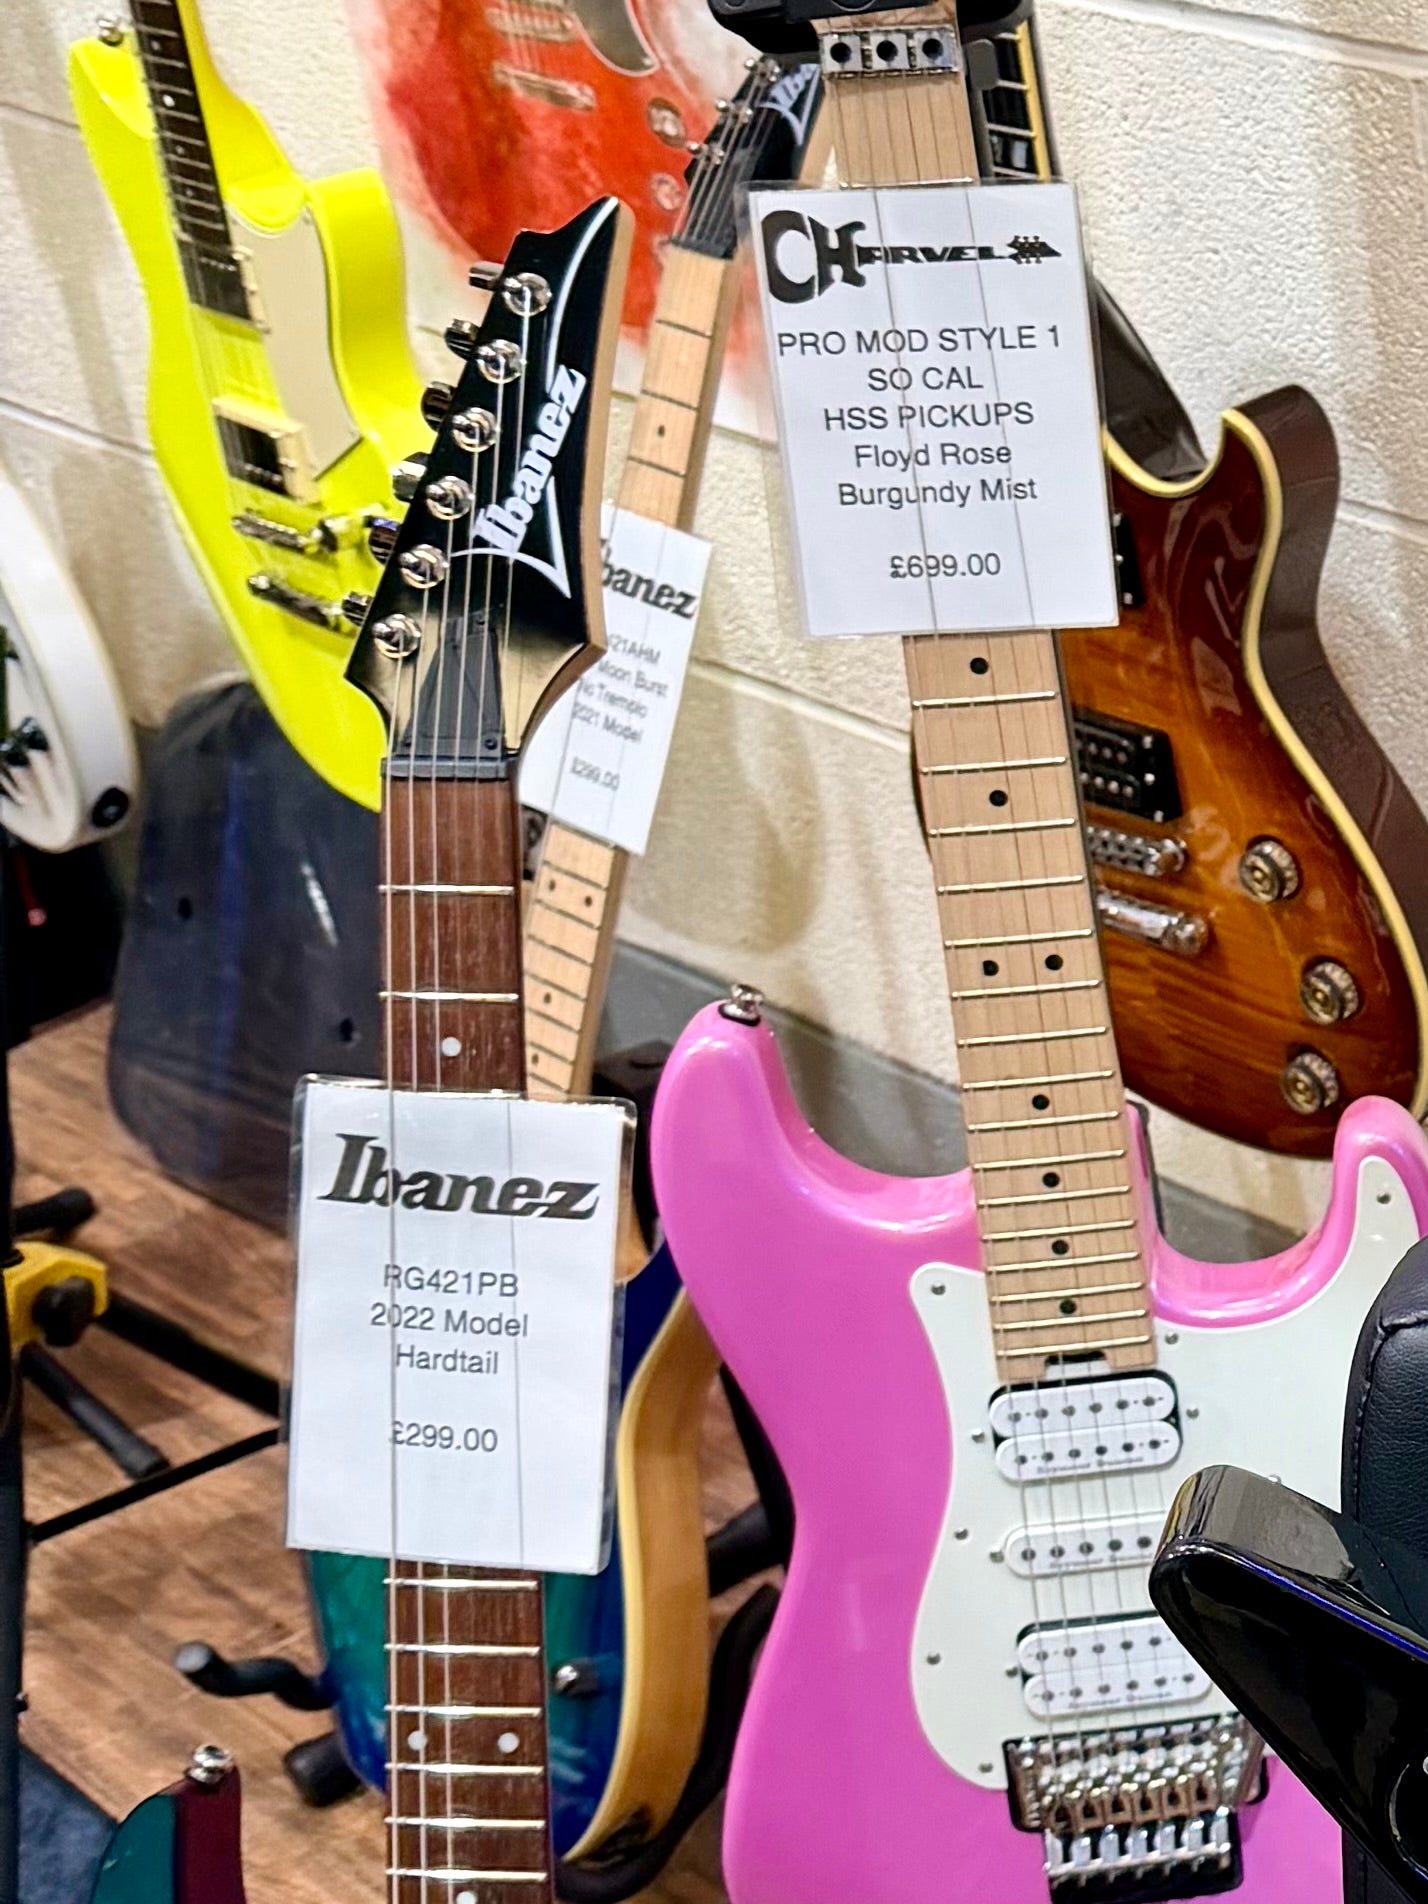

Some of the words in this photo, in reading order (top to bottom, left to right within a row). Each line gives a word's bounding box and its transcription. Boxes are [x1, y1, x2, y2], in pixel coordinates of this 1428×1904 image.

[777, 332, 846, 356] PRO
[856, 329, 929, 354] MOD
[938, 326, 1037, 352] STYLE
[1047, 325, 1060, 348] 1
[868, 367, 912, 392] SO
[922, 366, 984, 390] CAL
[824, 406, 889, 431] HSS
[898, 402, 1035, 429] PICKUPS
[473, 364, 587, 553] Ibanez
[854, 443, 931, 472] Floyd
[940, 442, 1013, 466] Rose
[838, 480, 972, 510] Burgundy
[980, 477, 1039, 501] Mist
[600, 539, 698, 620] banez
[889, 553, 1002, 579] £699.00
[316, 1132, 601, 1220] Ibanez
[383, 1263, 519, 1298] RG421PB
[370, 1302, 435, 1331] 2022
[444, 1308, 529, 1337] Model
[395, 1343, 499, 1375] Hardtail
[389, 1421, 498, 1453] £299.00
